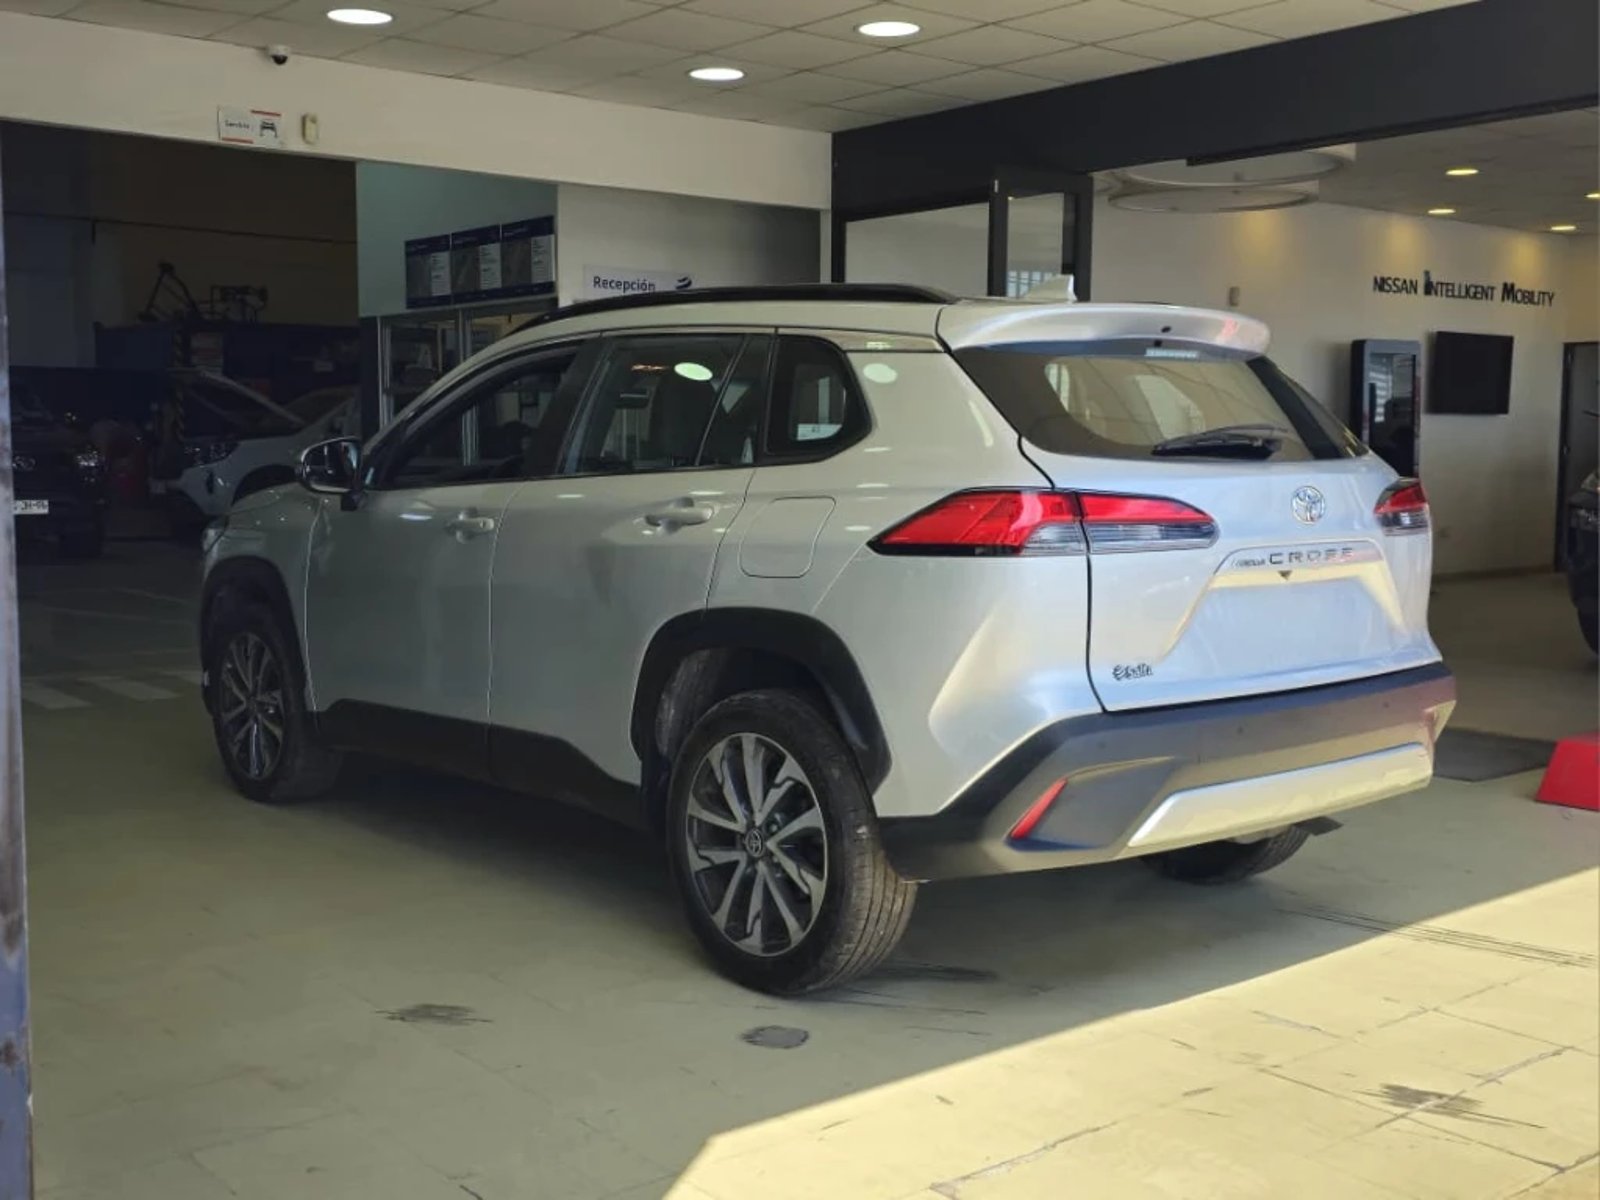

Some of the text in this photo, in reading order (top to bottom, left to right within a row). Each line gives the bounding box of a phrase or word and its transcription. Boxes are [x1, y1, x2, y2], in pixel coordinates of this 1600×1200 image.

[593, 276, 656, 293] Recepción
[1373, 270, 1556, 307] NISSAN INTELLIGENT MOBILITY
